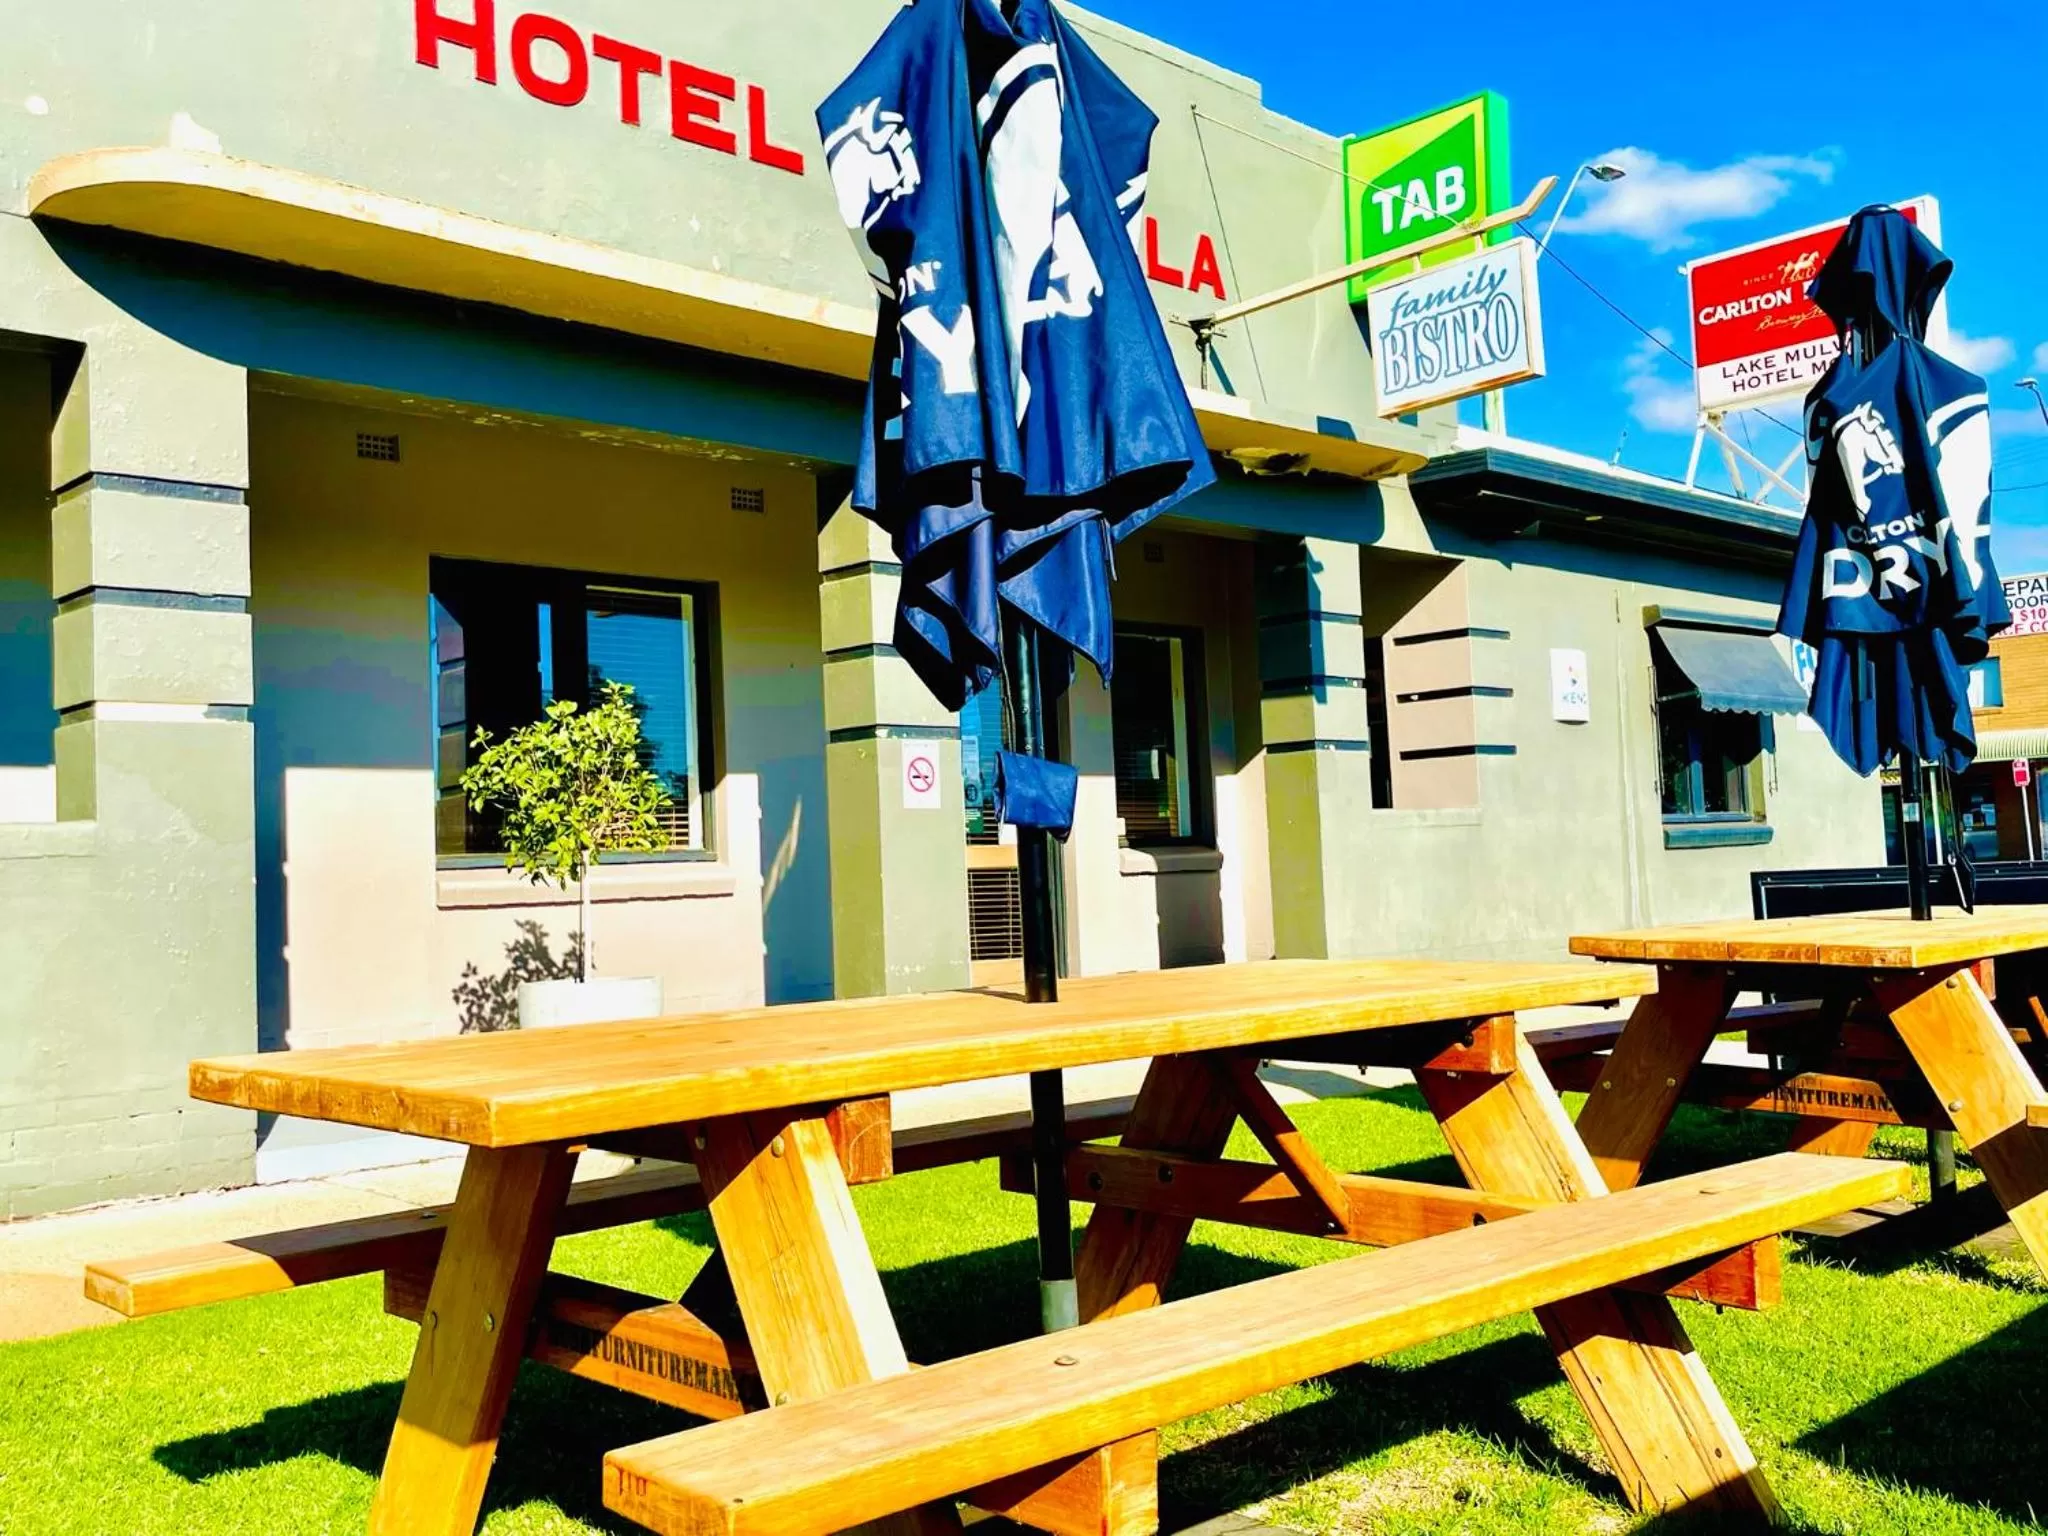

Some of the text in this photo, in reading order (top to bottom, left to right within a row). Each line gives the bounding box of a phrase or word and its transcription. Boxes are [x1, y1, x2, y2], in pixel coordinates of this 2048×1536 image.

[415, 0, 804, 176] HOTEL
[1371, 165, 1467, 236] TAB
[1389, 264, 1507, 330] family
[1699, 286, 1793, 326] CARLTON
[1380, 293, 1519, 395] BISTRO
[1722, 354, 1777, 379] LAKE
[1732, 366, 1803, 393] HOTEL
[1822, 516, 1951, 601] DRY
